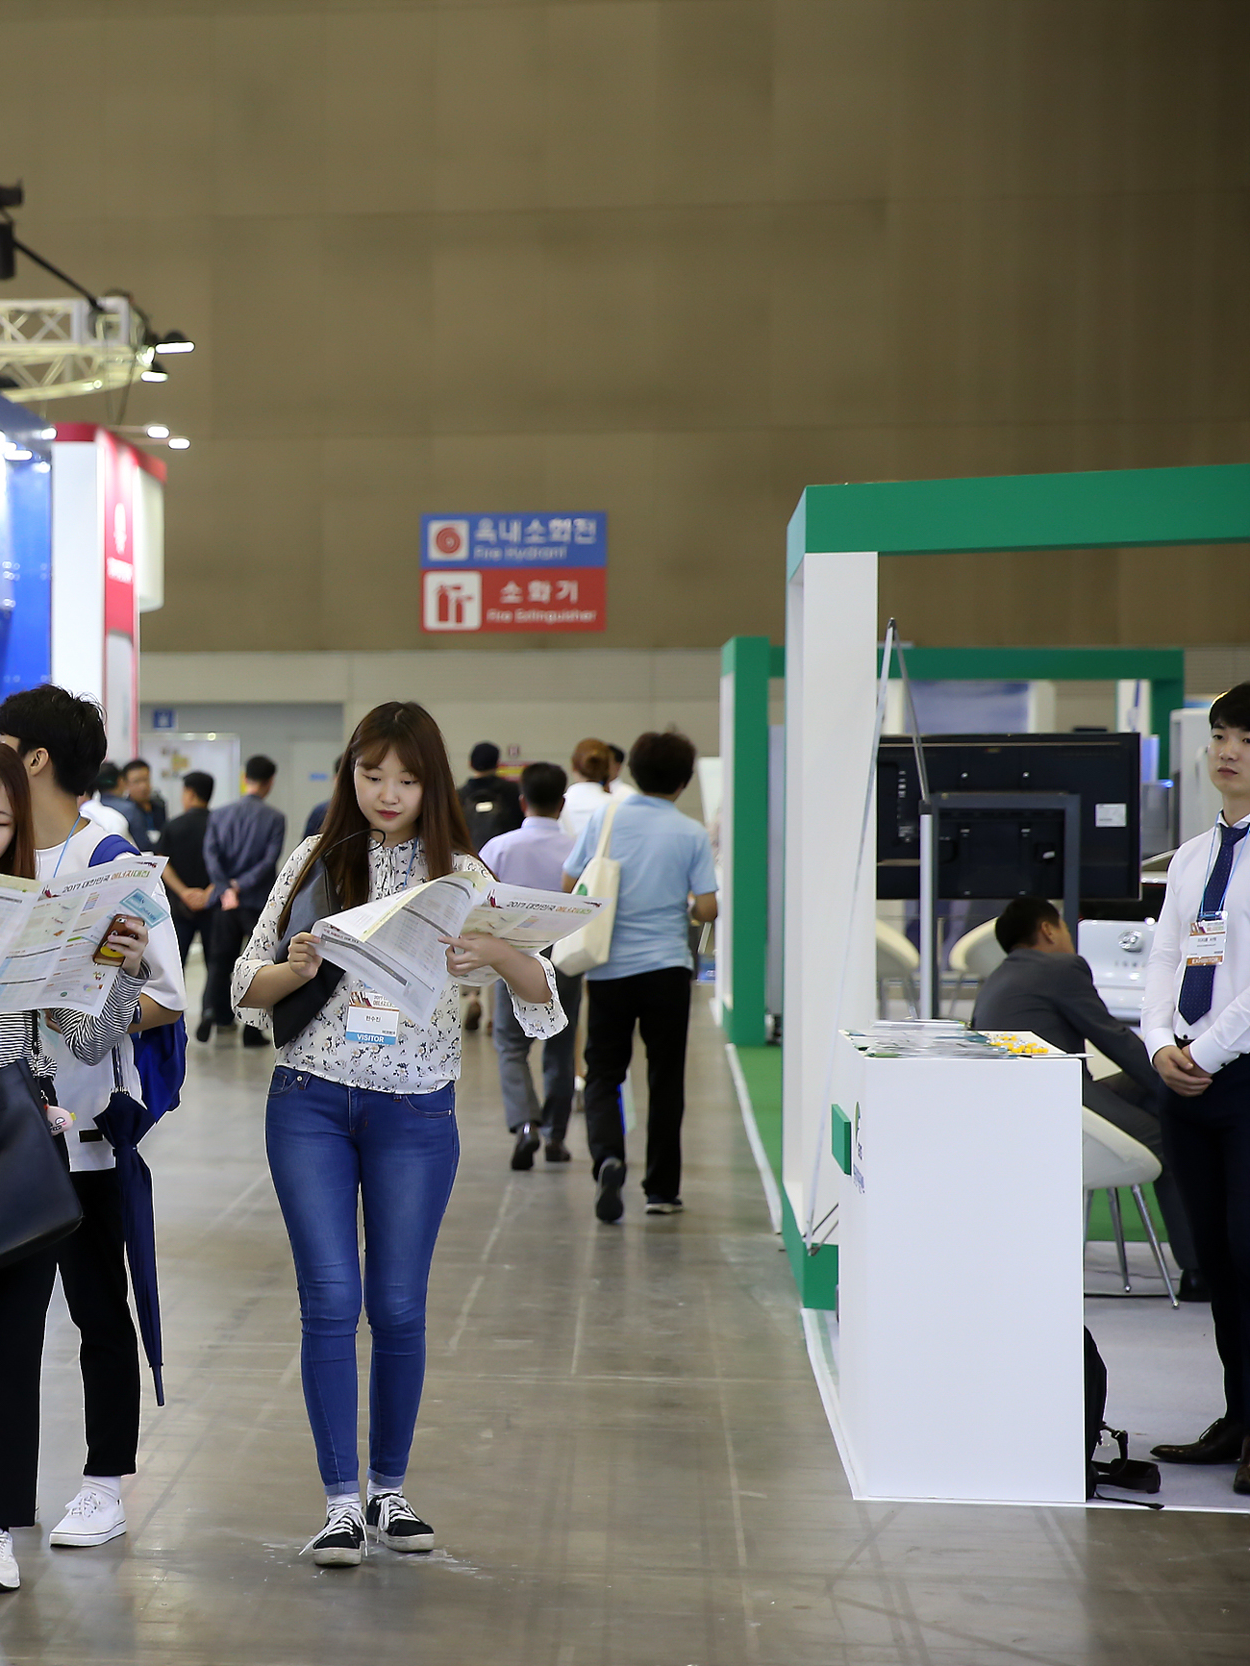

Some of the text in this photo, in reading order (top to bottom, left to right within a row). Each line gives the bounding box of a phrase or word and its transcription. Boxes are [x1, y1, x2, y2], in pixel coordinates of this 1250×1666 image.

[475, 518, 597, 544] 옥내소화전
[500, 579, 579, 604] 소화기
[62, 883, 82, 894] 2017
[507, 900, 526, 908] 2017
[357, 1034, 385, 1043] VISITOR
